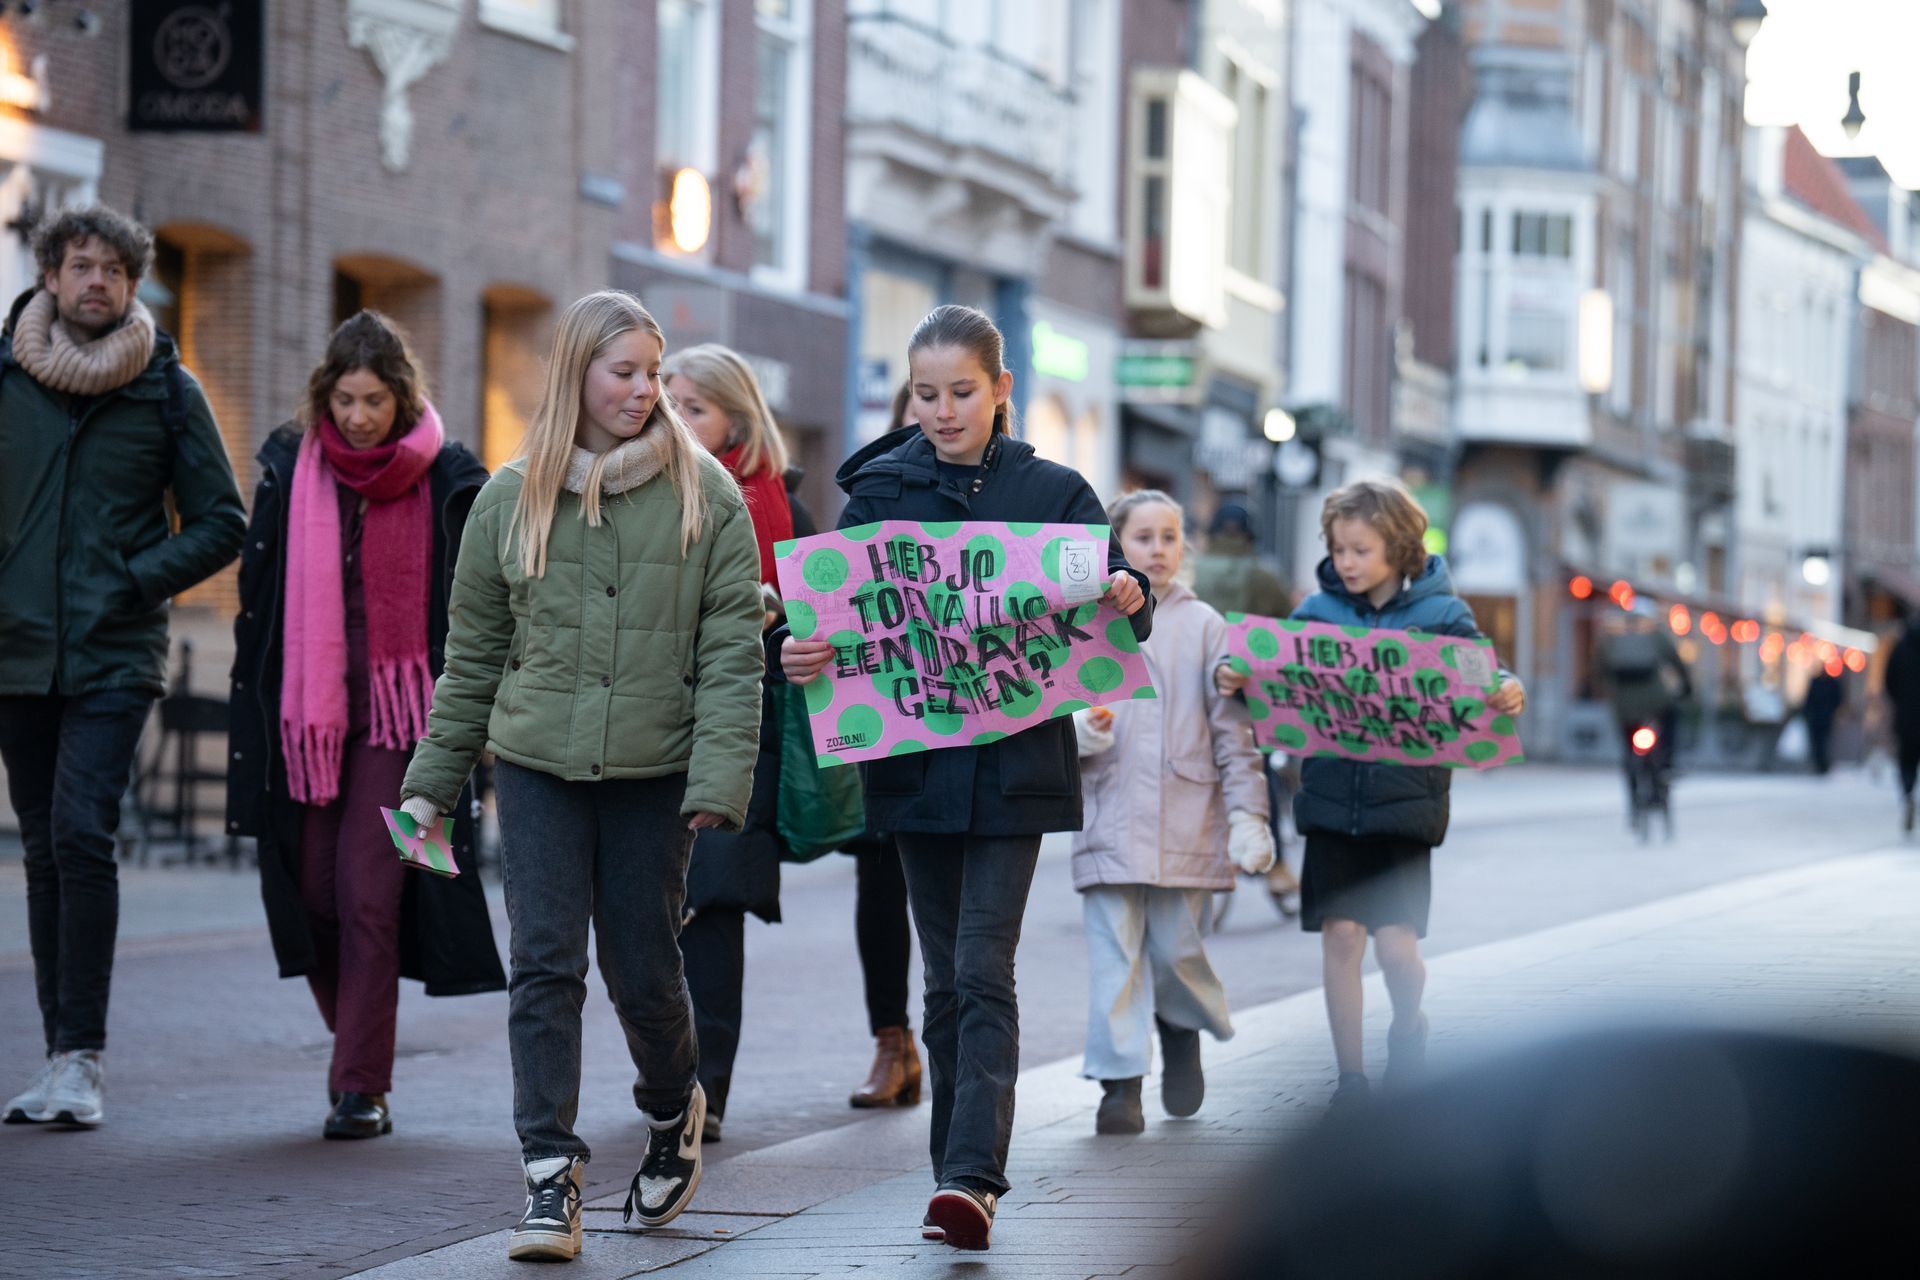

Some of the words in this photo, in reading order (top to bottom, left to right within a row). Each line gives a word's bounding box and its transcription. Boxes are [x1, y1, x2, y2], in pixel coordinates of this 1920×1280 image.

[866, 541, 941, 584] HEB
[835, 633, 914, 679] EEN
[917, 606, 1094, 680] DRAAK
[1294, 637, 1357, 669] HEB
[892, 650, 1055, 720] GEZIEN?
[1267, 684, 1330, 717] EEN
[1333, 695, 1478, 737] DRAAK
[826, 732, 866, 748] ZOZO.NU
[1315, 715, 1444, 750] GEZIEN?
